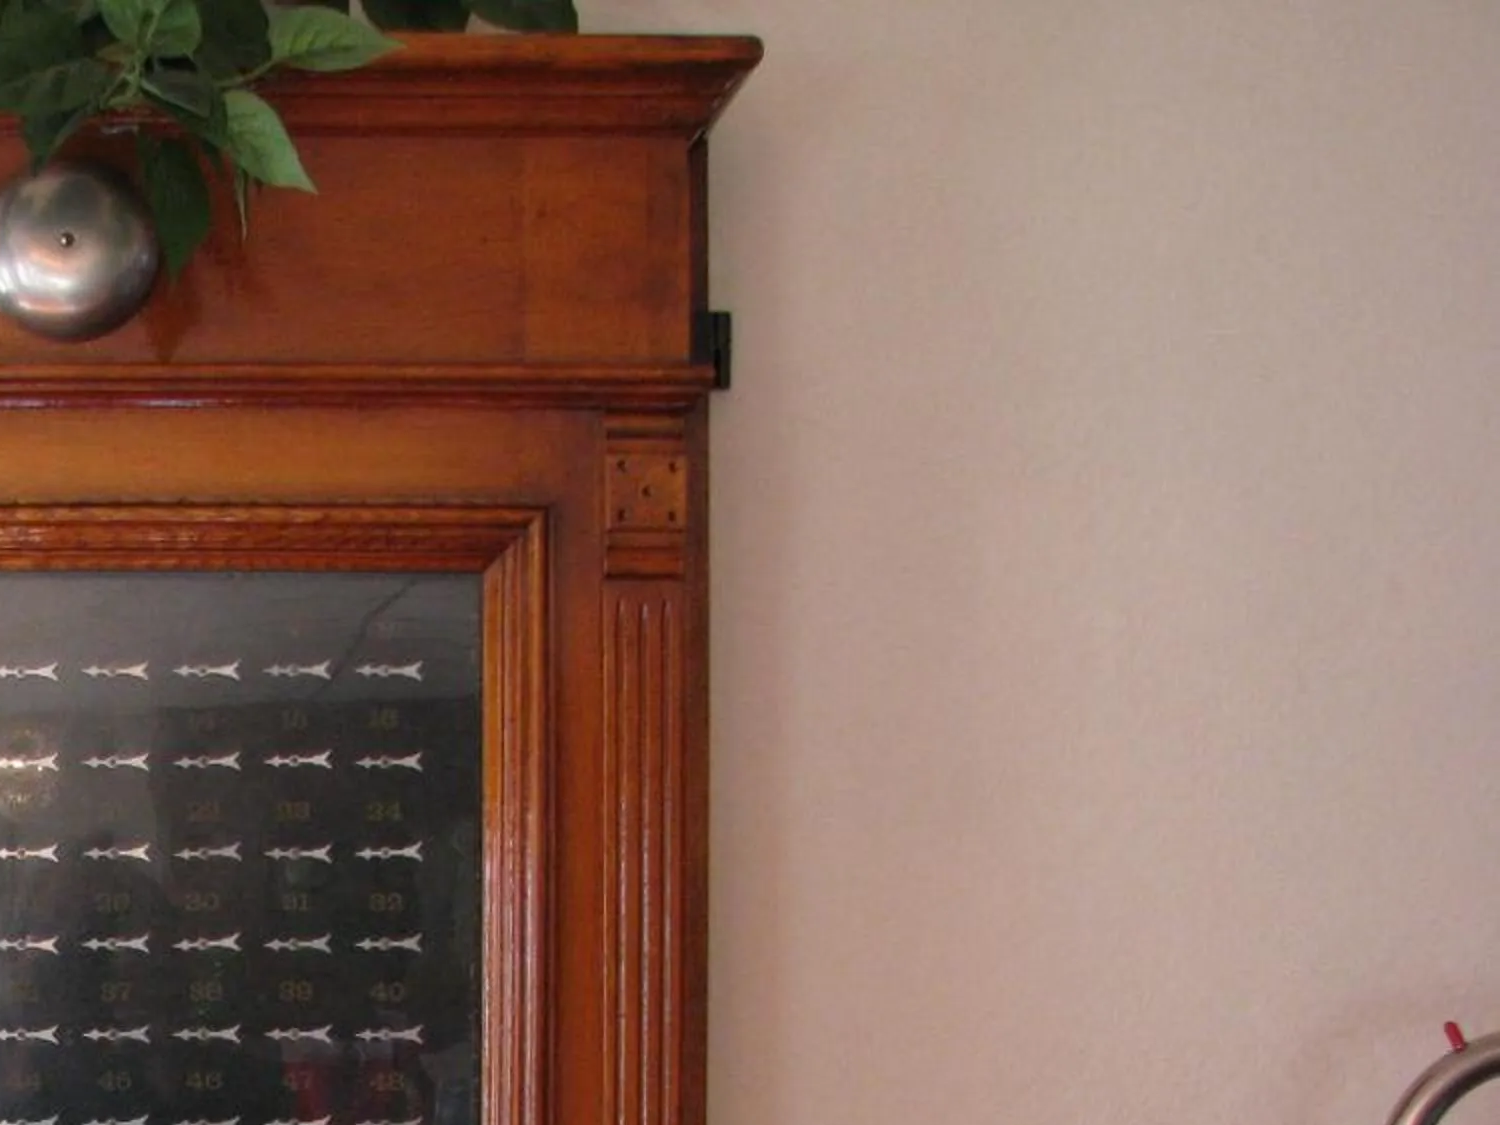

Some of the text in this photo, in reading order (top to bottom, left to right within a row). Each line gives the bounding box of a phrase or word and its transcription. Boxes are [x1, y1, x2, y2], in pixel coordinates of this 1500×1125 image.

[369, 981, 406, 1003] 40
[282, 1069, 314, 1091] 47
[369, 1069, 405, 1092] 48
